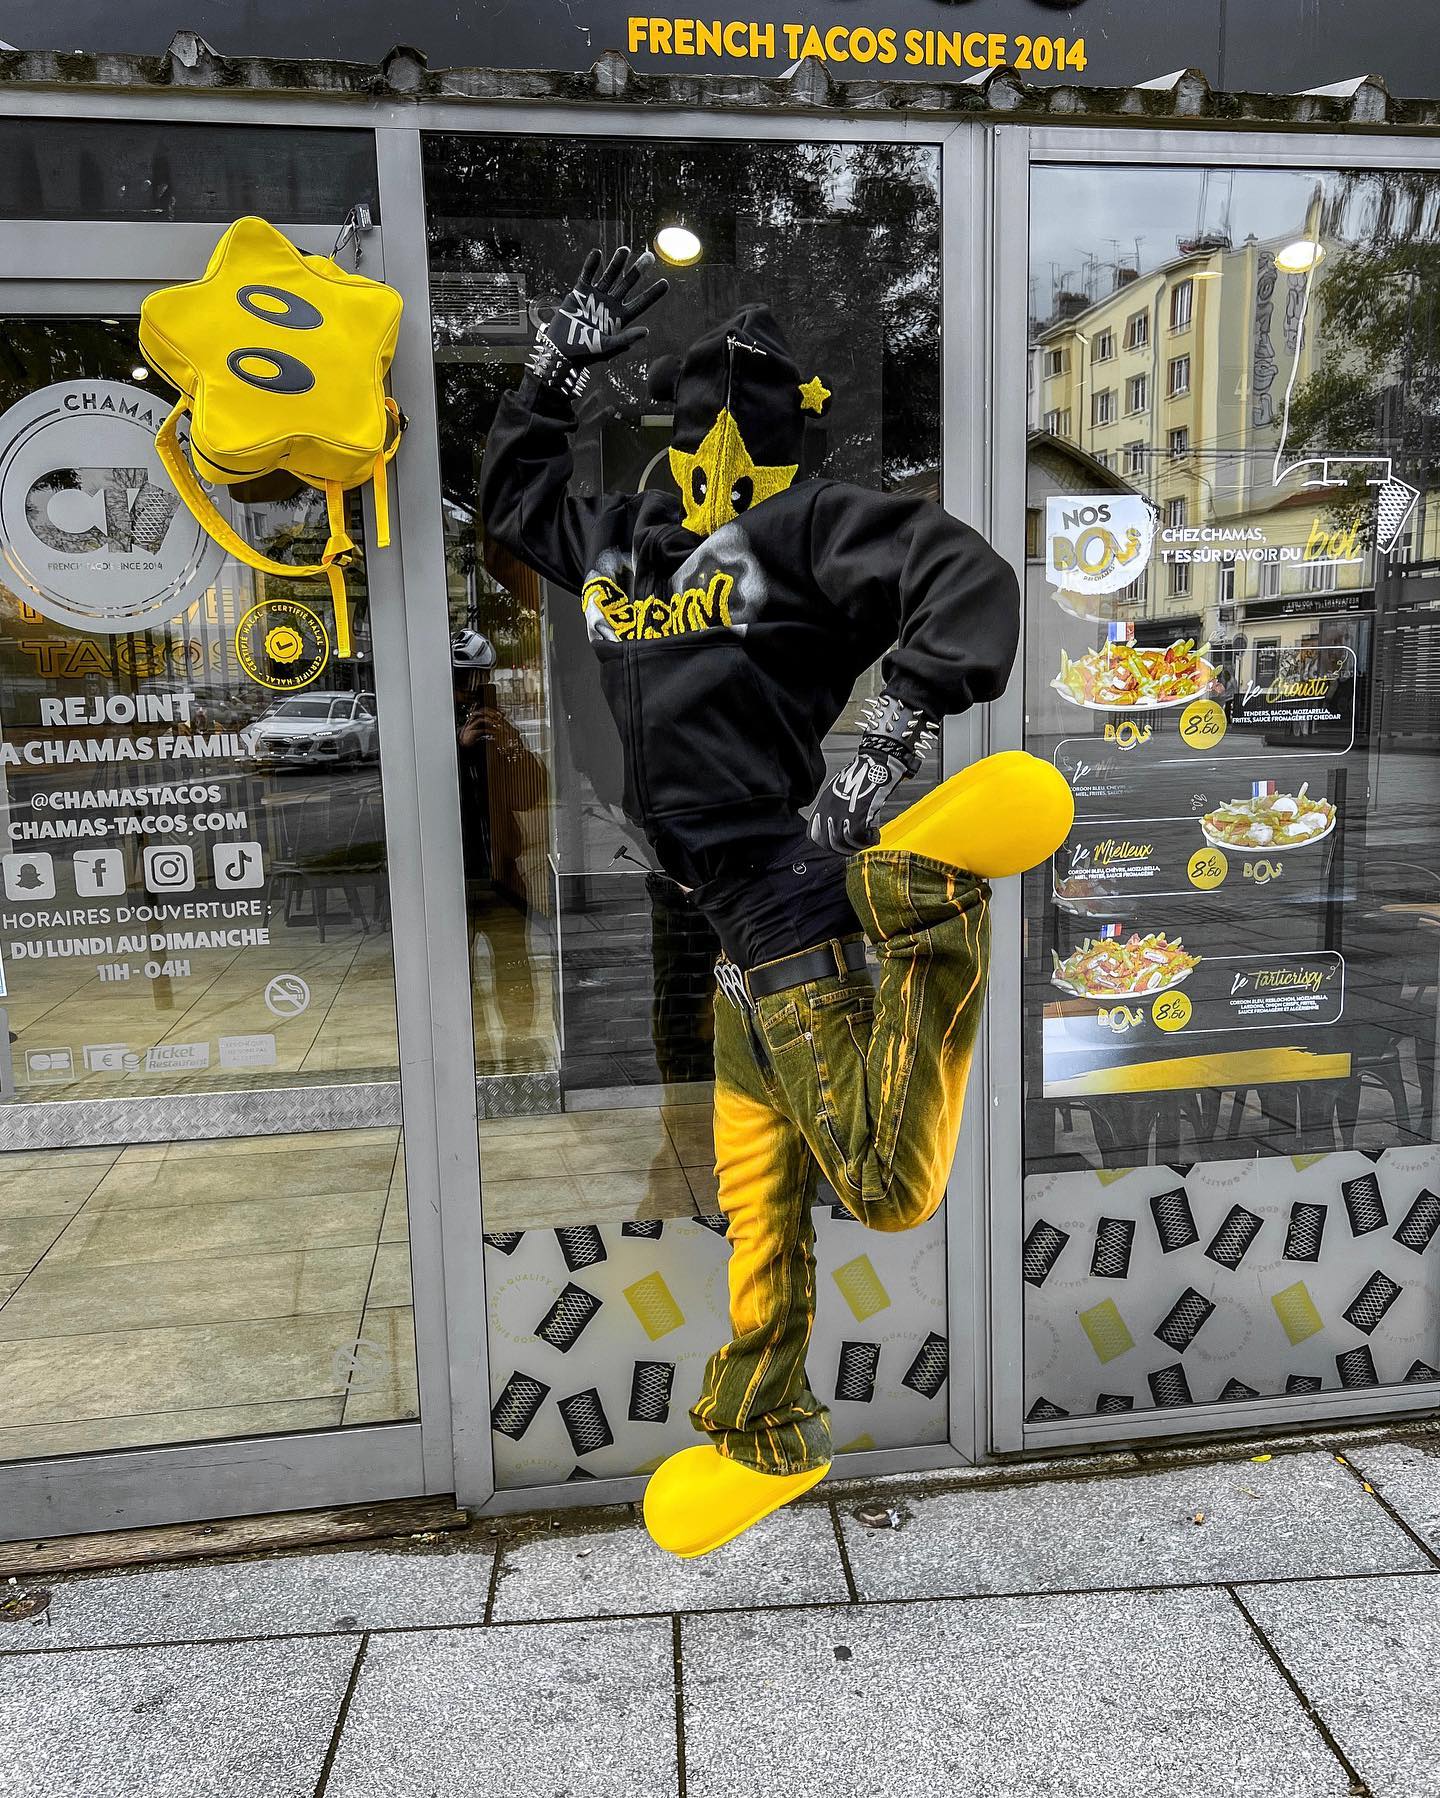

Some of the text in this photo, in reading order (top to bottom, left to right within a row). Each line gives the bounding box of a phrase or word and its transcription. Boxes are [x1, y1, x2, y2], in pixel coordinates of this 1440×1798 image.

[627, 17, 1087, 71] FRENCH TACOS SINCE 2014
[1062, 504, 1111, 530] NOS
[1161, 528, 1266, 543] CHEZ CHAMAS,
[1161, 518, 1361, 563] T'ES SÛR D'AVOIR DU bol
[272, 604, 324, 646] CERTIFIÉ HALAL
[241, 611, 263, 672] CERTIFIÉ HALAL
[265, 656, 322, 686] CERTIFIÉ HALAL
[40, 693, 196, 726] REJOINT
[24, 737, 154, 764] CHAMAS
[158, 732, 261, 759] FAMILY
[31, 785, 222, 811] @CHAMASTACOS
[7, 811, 248, 840] CHAMAS-TACOS.COM
[1094, 839, 1153, 865] Mielleux
[2, 908, 111, 929] HORAIRES
[10, 927, 271, 960] DU LUNDI AU DIMANCHE
[97, 964, 129, 982] 11H
[144, 959, 191, 980] 04H
[1248, 968, 1324, 992] Tarticrispy
[149, 1046, 195, 1060] Ticket
